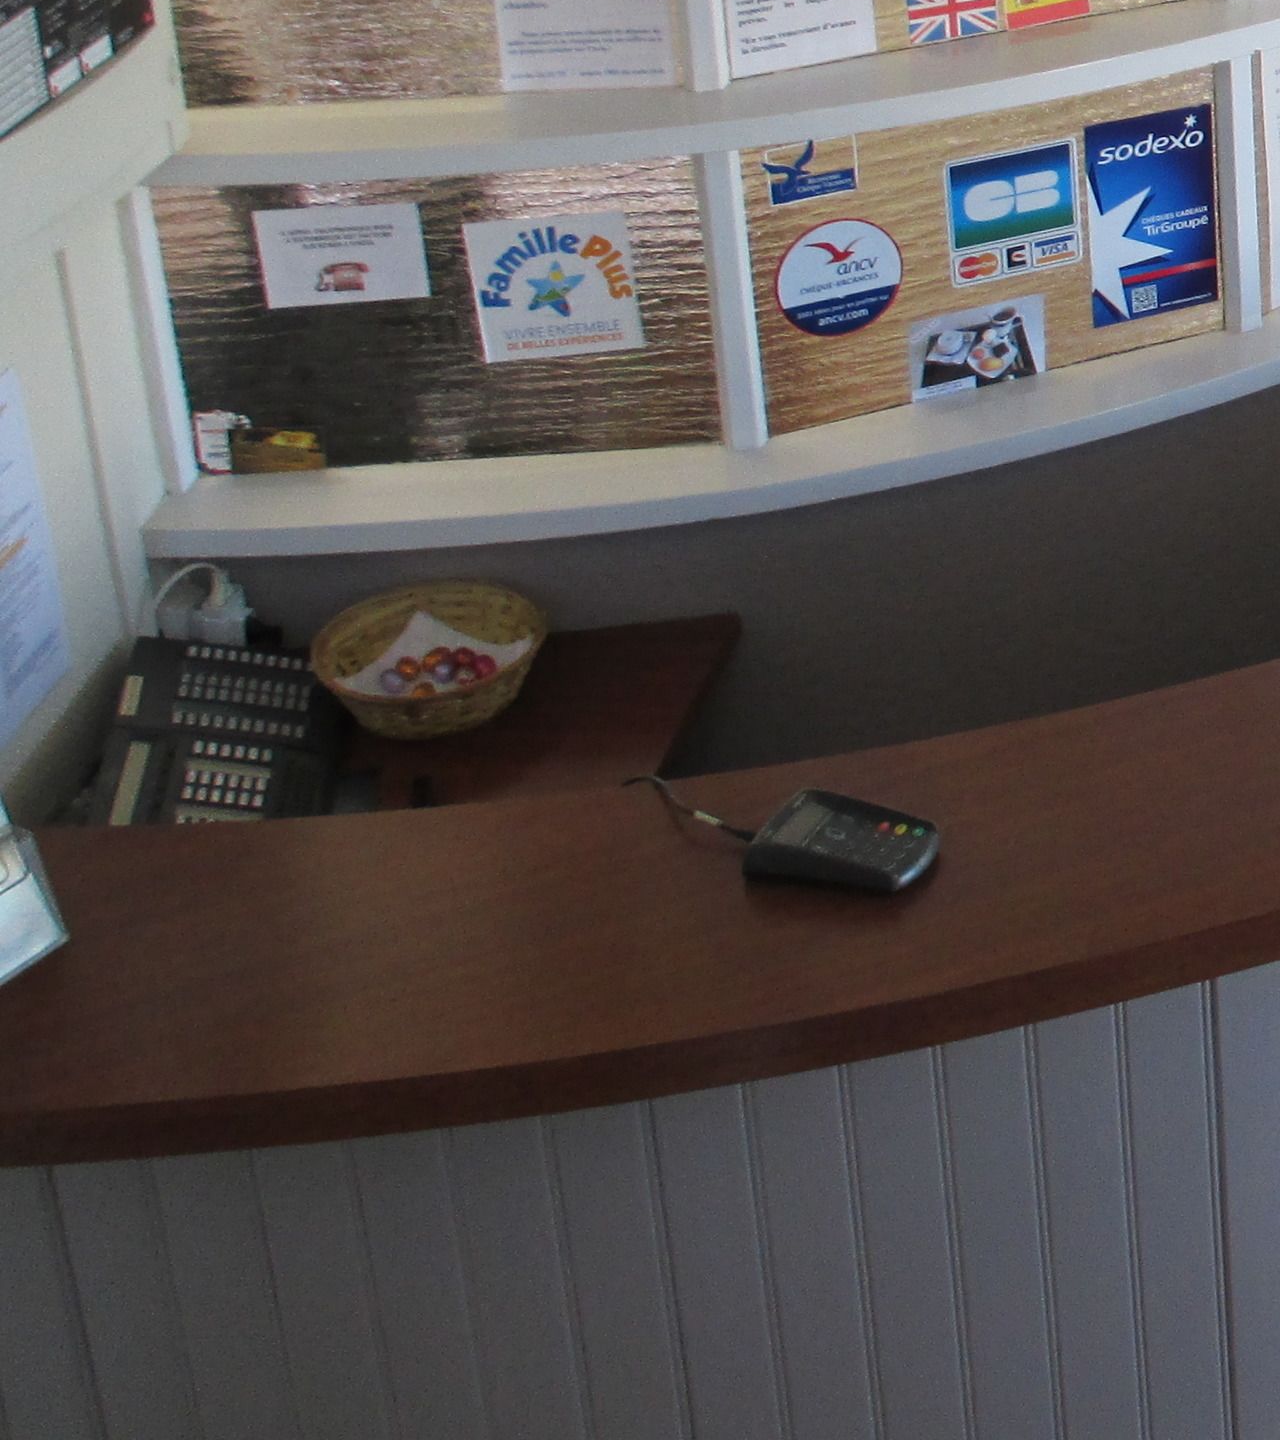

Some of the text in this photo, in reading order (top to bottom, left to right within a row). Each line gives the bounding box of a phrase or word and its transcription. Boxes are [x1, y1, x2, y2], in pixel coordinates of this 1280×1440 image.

[1097, 128, 1205, 165] sodexo
[963, 170, 1061, 222] CB
[1142, 215, 1209, 237] TirGroupé
[1041, 241, 1070, 257] VISA
[481, 226, 634, 308] Famille Plus
[836, 256, 880, 276] ancv
[818, 308, 870, 327] ancv.com
[504, 319, 621, 341] VIVRE ENSEMBLE
